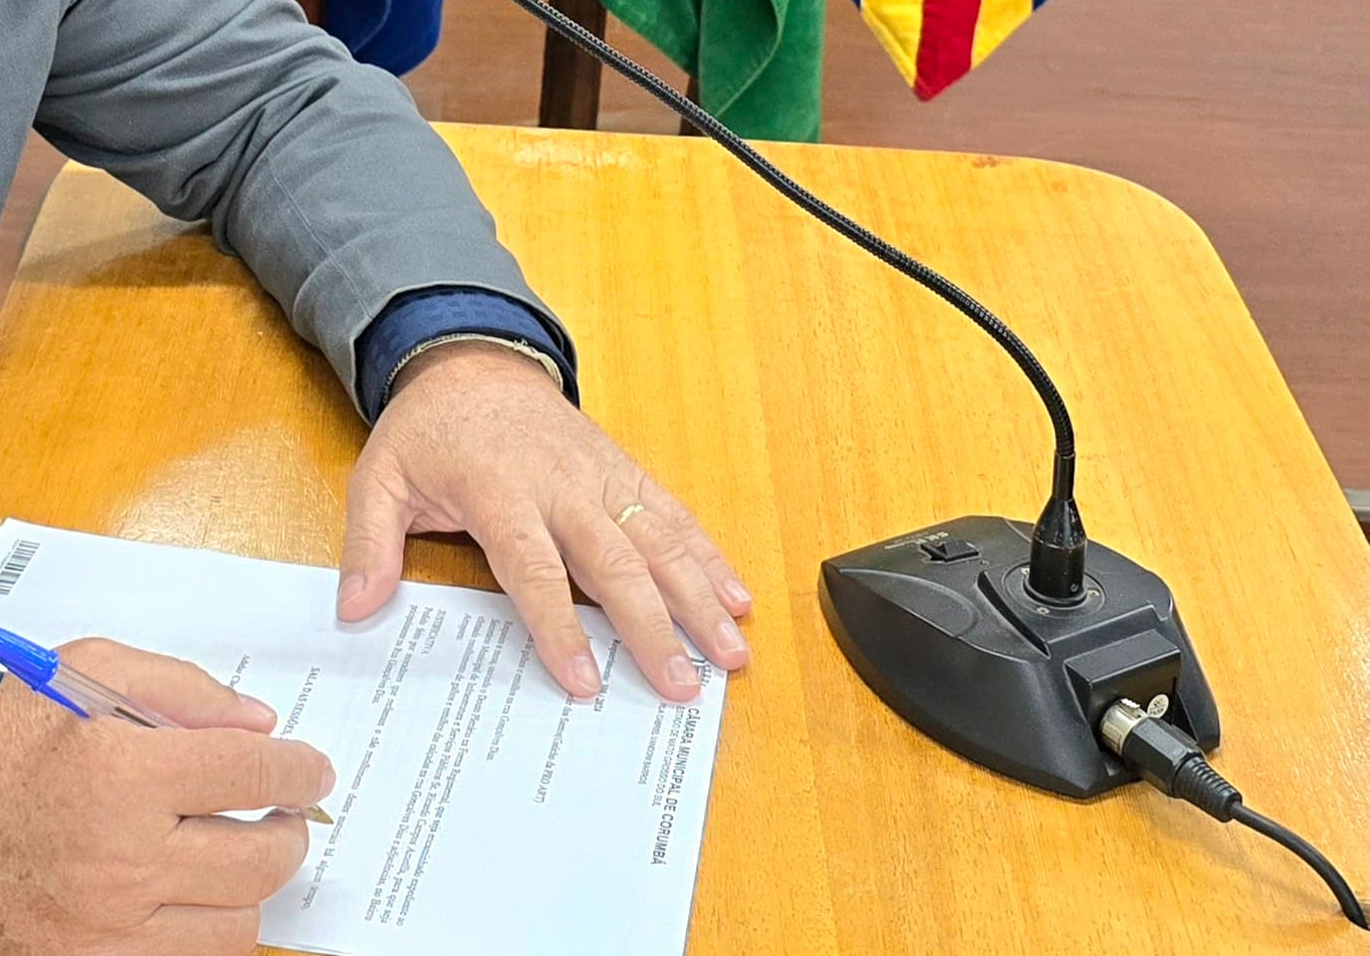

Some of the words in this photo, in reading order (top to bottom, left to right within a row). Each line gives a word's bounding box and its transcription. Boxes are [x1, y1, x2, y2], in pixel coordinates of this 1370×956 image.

[304, 666, 321, 686] SALA
[297, 687, 312, 702] DAS
[280, 702, 305, 736] SESSÕES,
[672, 704, 686, 729] ESTADO
[680, 708, 700, 744] CÂMARA
[669, 729, 680, 738] DE
[664, 738, 677, 756] MATO
[657, 756, 673, 783] GROSSO
[667, 746, 691, 796] MUNICIPAL
[655, 783, 666, 794] DO
[651, 794, 663, 807] SUL
[663, 797, 678, 812] DE
[651, 813, 674, 865] CORUMBÁ
